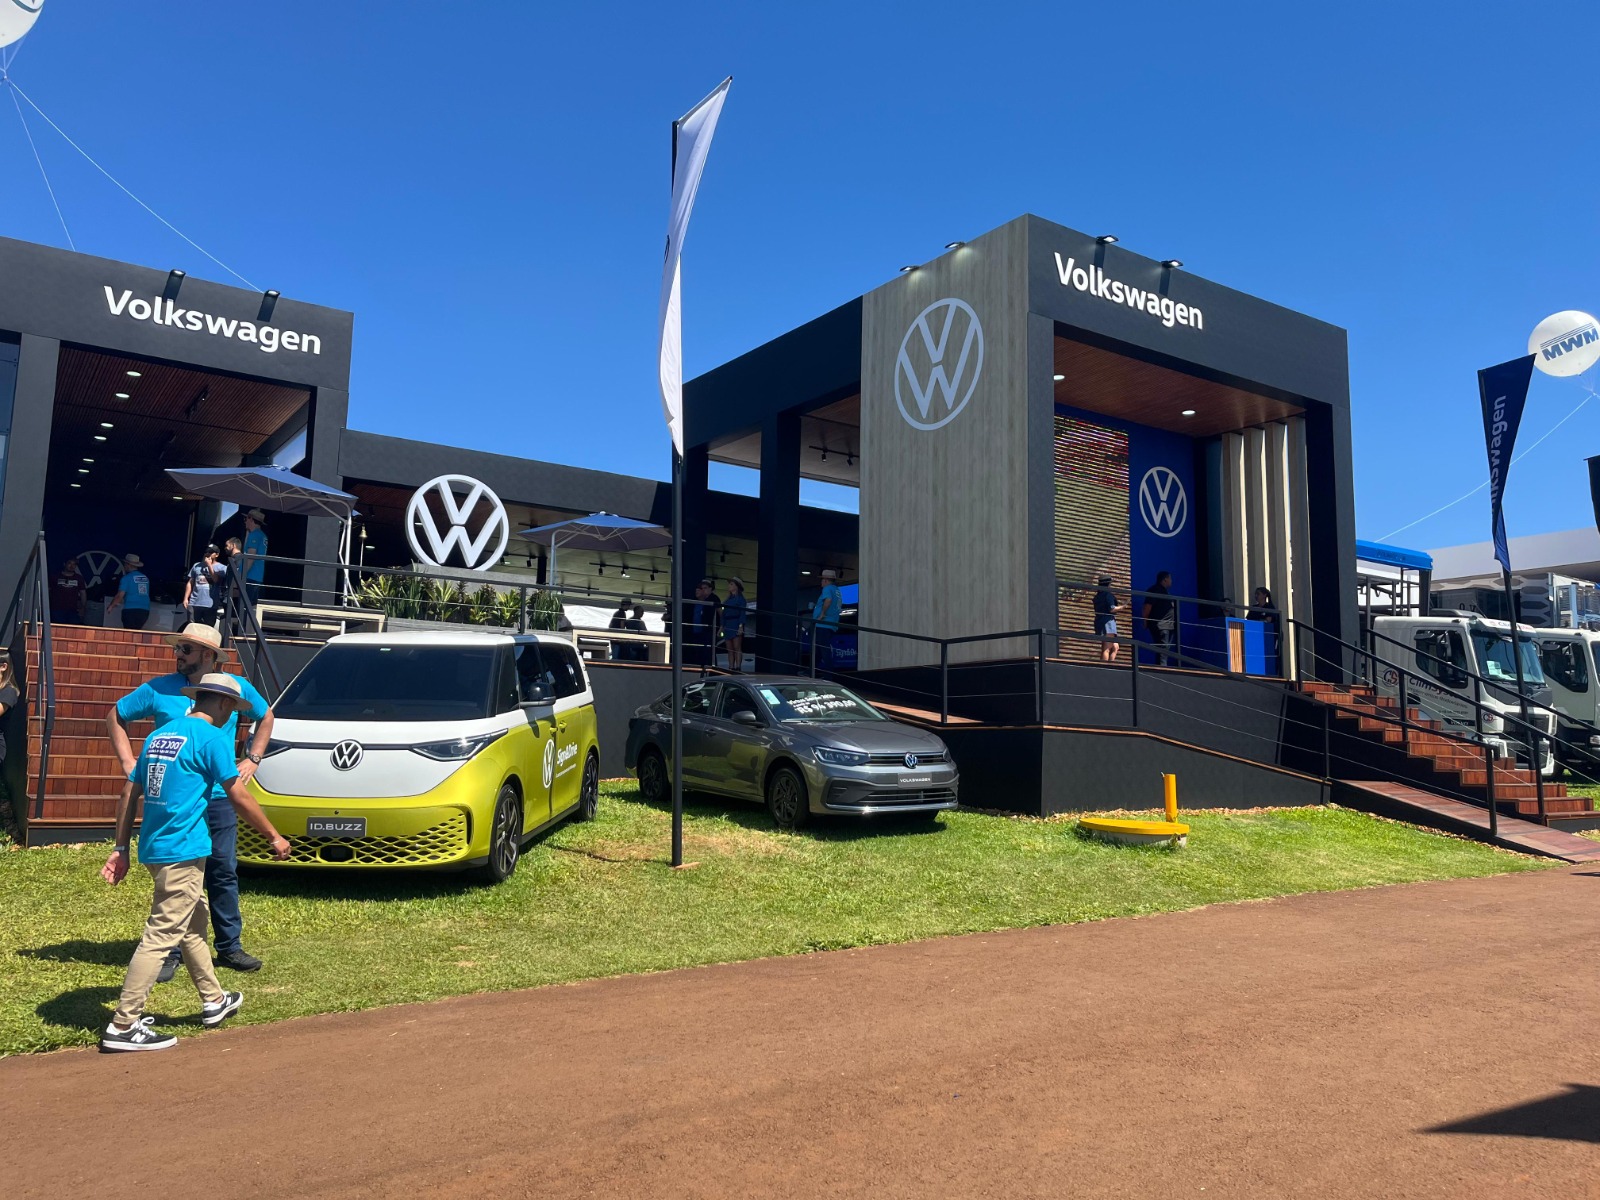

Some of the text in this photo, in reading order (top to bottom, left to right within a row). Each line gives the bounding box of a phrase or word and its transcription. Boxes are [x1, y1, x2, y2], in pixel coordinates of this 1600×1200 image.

[1054, 252, 1203, 330] Volkswagen
[103, 285, 321, 355] Volkswagen
[1541, 327, 1600, 362] MWM
[310, 823, 363, 831] ID.BUZZ
